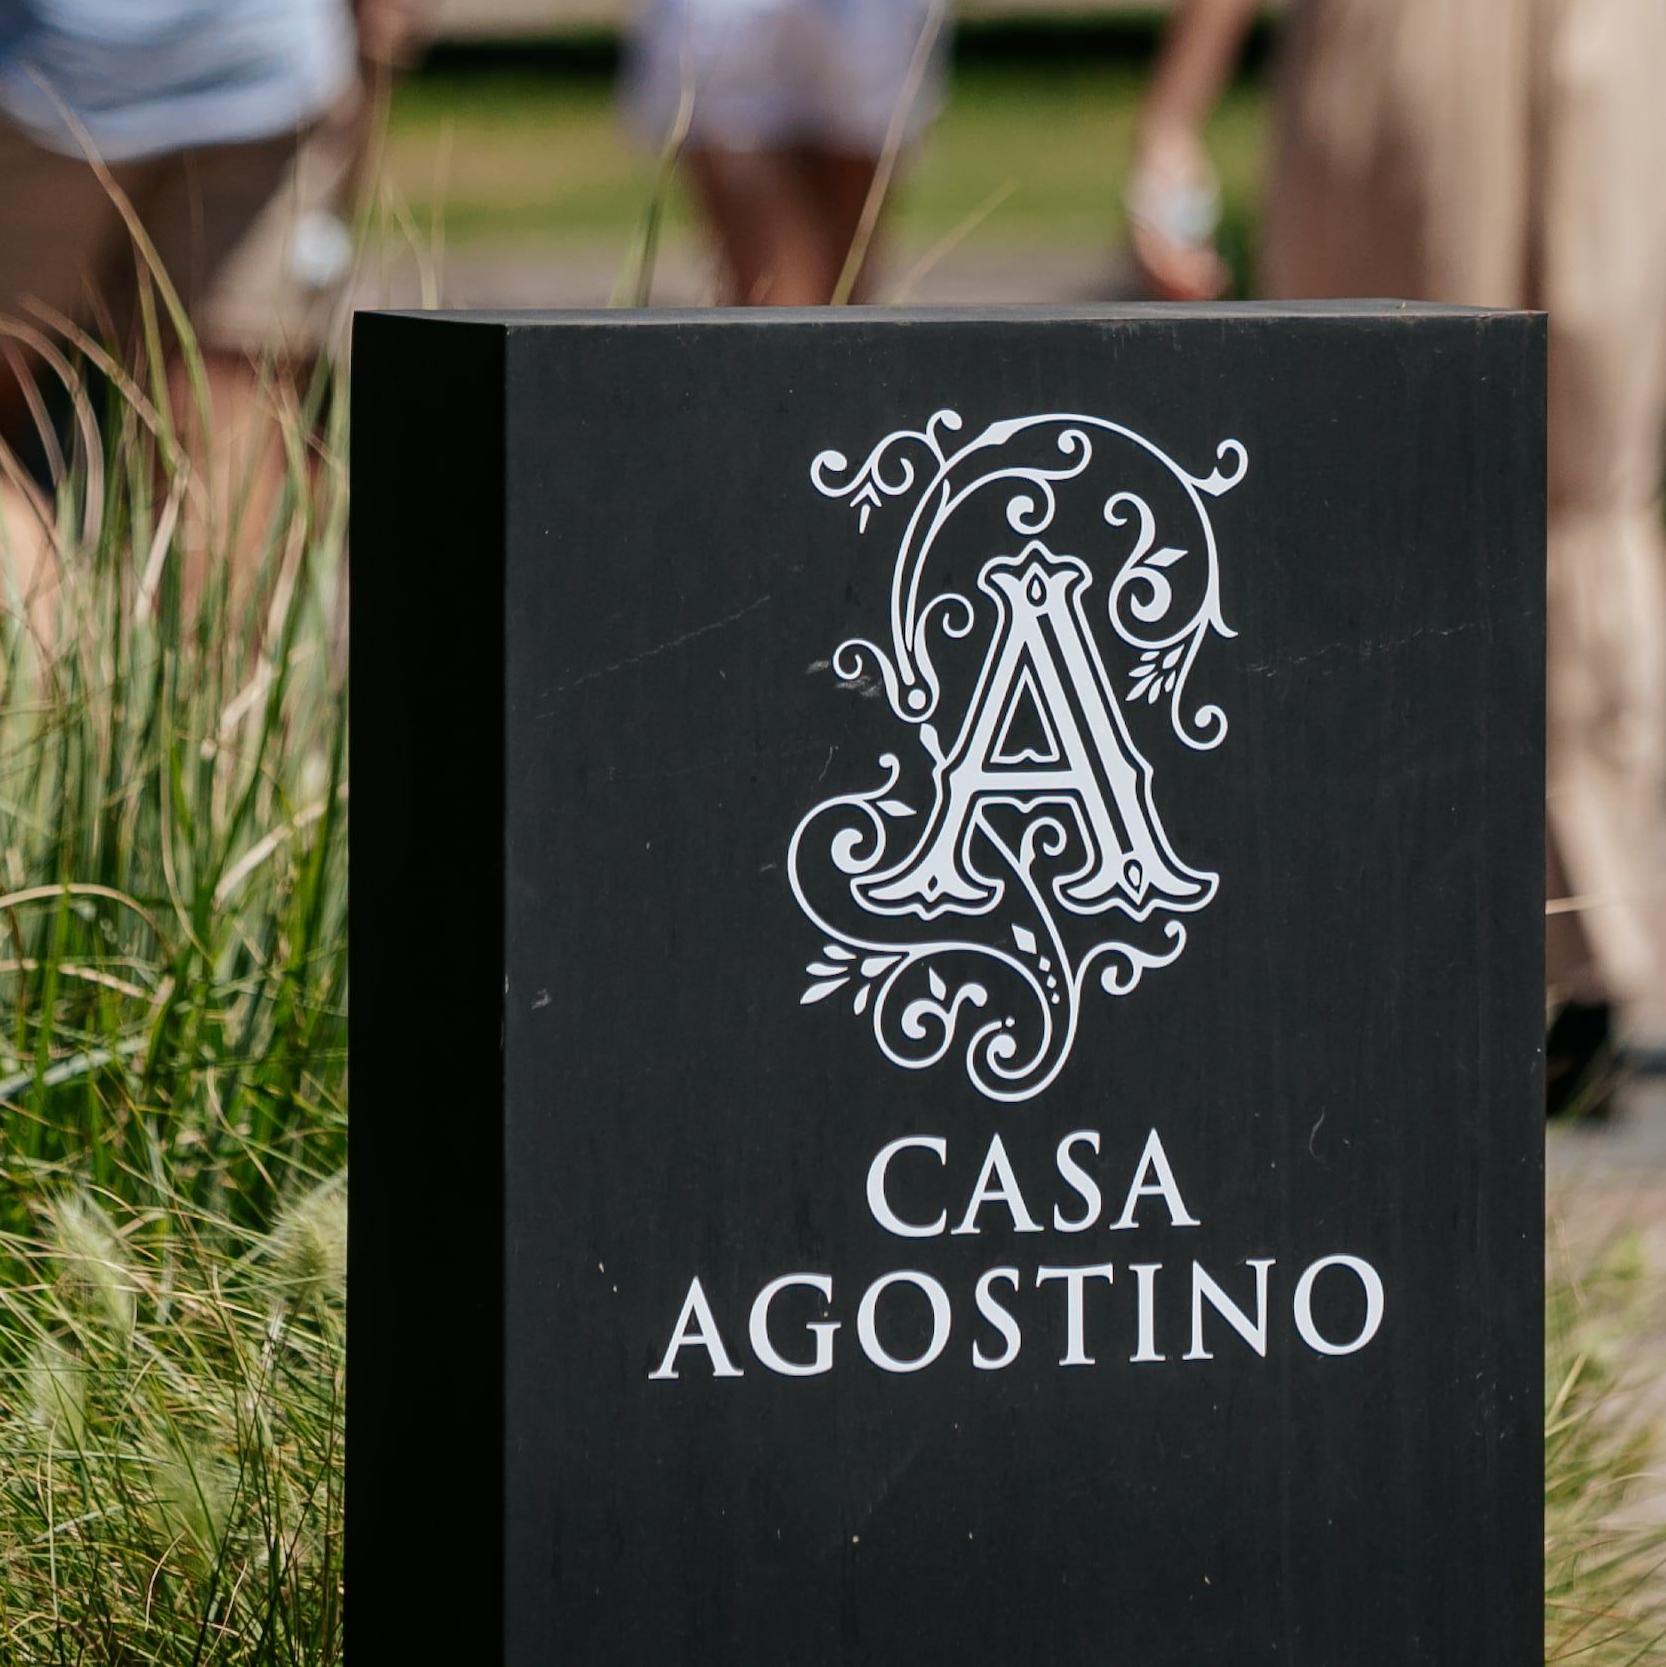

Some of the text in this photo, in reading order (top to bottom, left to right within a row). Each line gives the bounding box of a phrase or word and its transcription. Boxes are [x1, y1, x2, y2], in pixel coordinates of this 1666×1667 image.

[849, 539, 1220, 922] A
[865, 1127, 1202, 1238] CASA
[646, 1253, 1386, 1380] AGOSTINO
